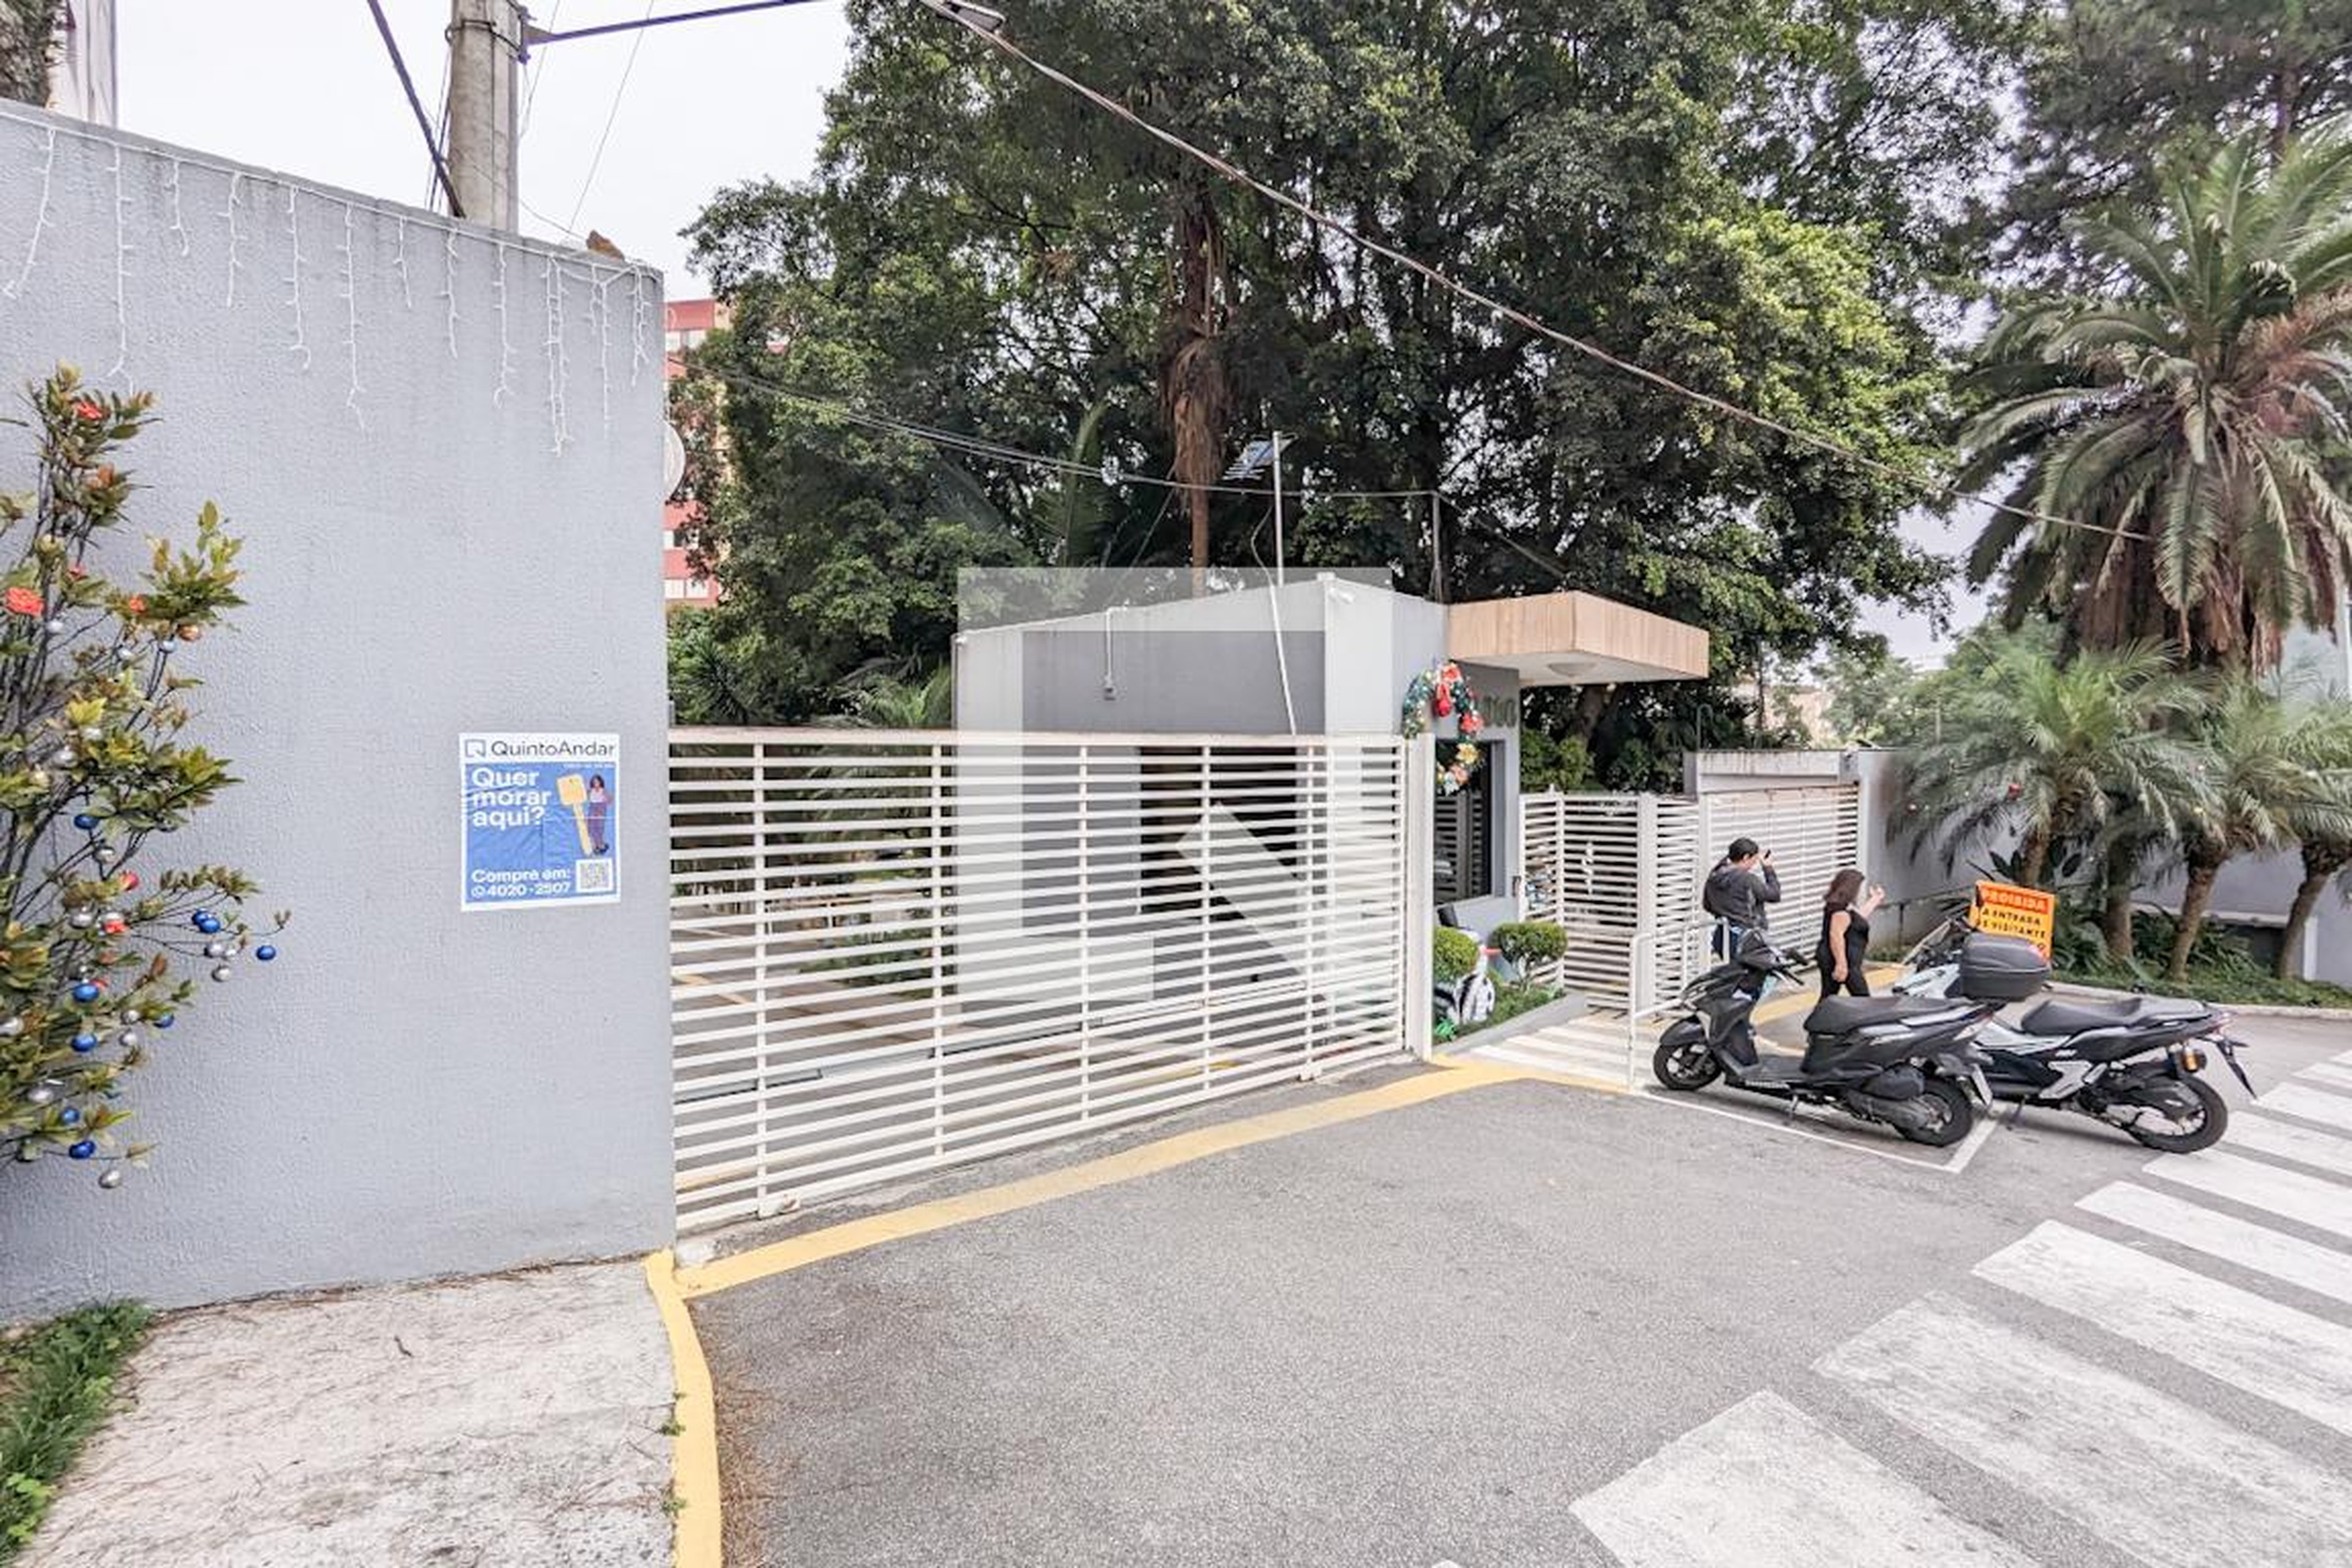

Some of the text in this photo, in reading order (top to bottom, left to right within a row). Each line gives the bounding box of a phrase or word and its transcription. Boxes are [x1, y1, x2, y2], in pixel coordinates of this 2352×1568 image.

[491, 740, 616, 756] QuintoAndar
[472, 767, 539, 786] Quer
[471, 790, 551, 807] morar
[472, 807, 545, 830] aqui?
[471, 869, 539, 883] Compra
